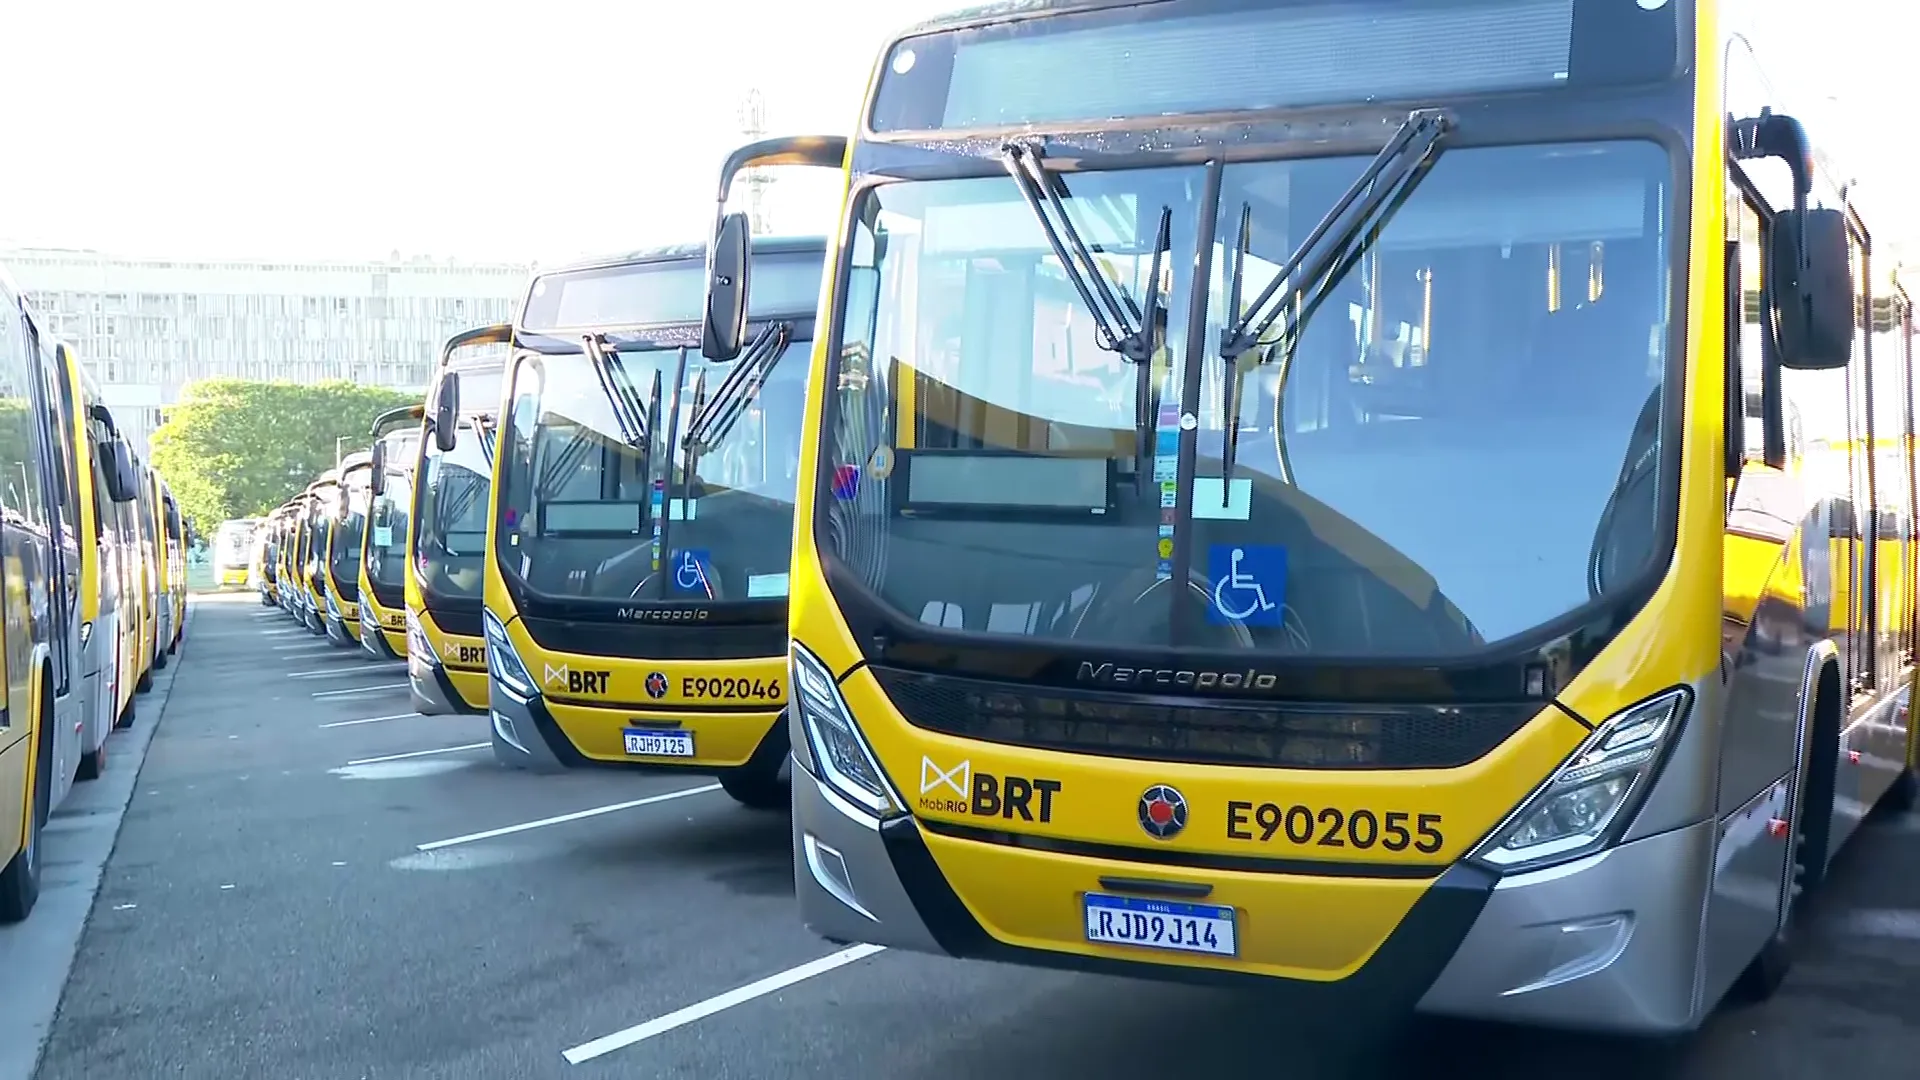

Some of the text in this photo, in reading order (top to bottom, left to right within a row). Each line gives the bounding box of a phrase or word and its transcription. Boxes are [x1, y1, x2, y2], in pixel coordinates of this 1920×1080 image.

[617, 607, 709, 620] Marcopolo
[569, 670, 611, 694] BRT
[682, 677, 781, 700] E902046
[1076, 661, 1277, 691] Marcopolo
[919, 798, 968, 814] MobiRIO
[971, 772, 1062, 824] BRT
[1227, 800, 1444, 854] E902055
[1099, 910, 1218, 949] RJD9J14
